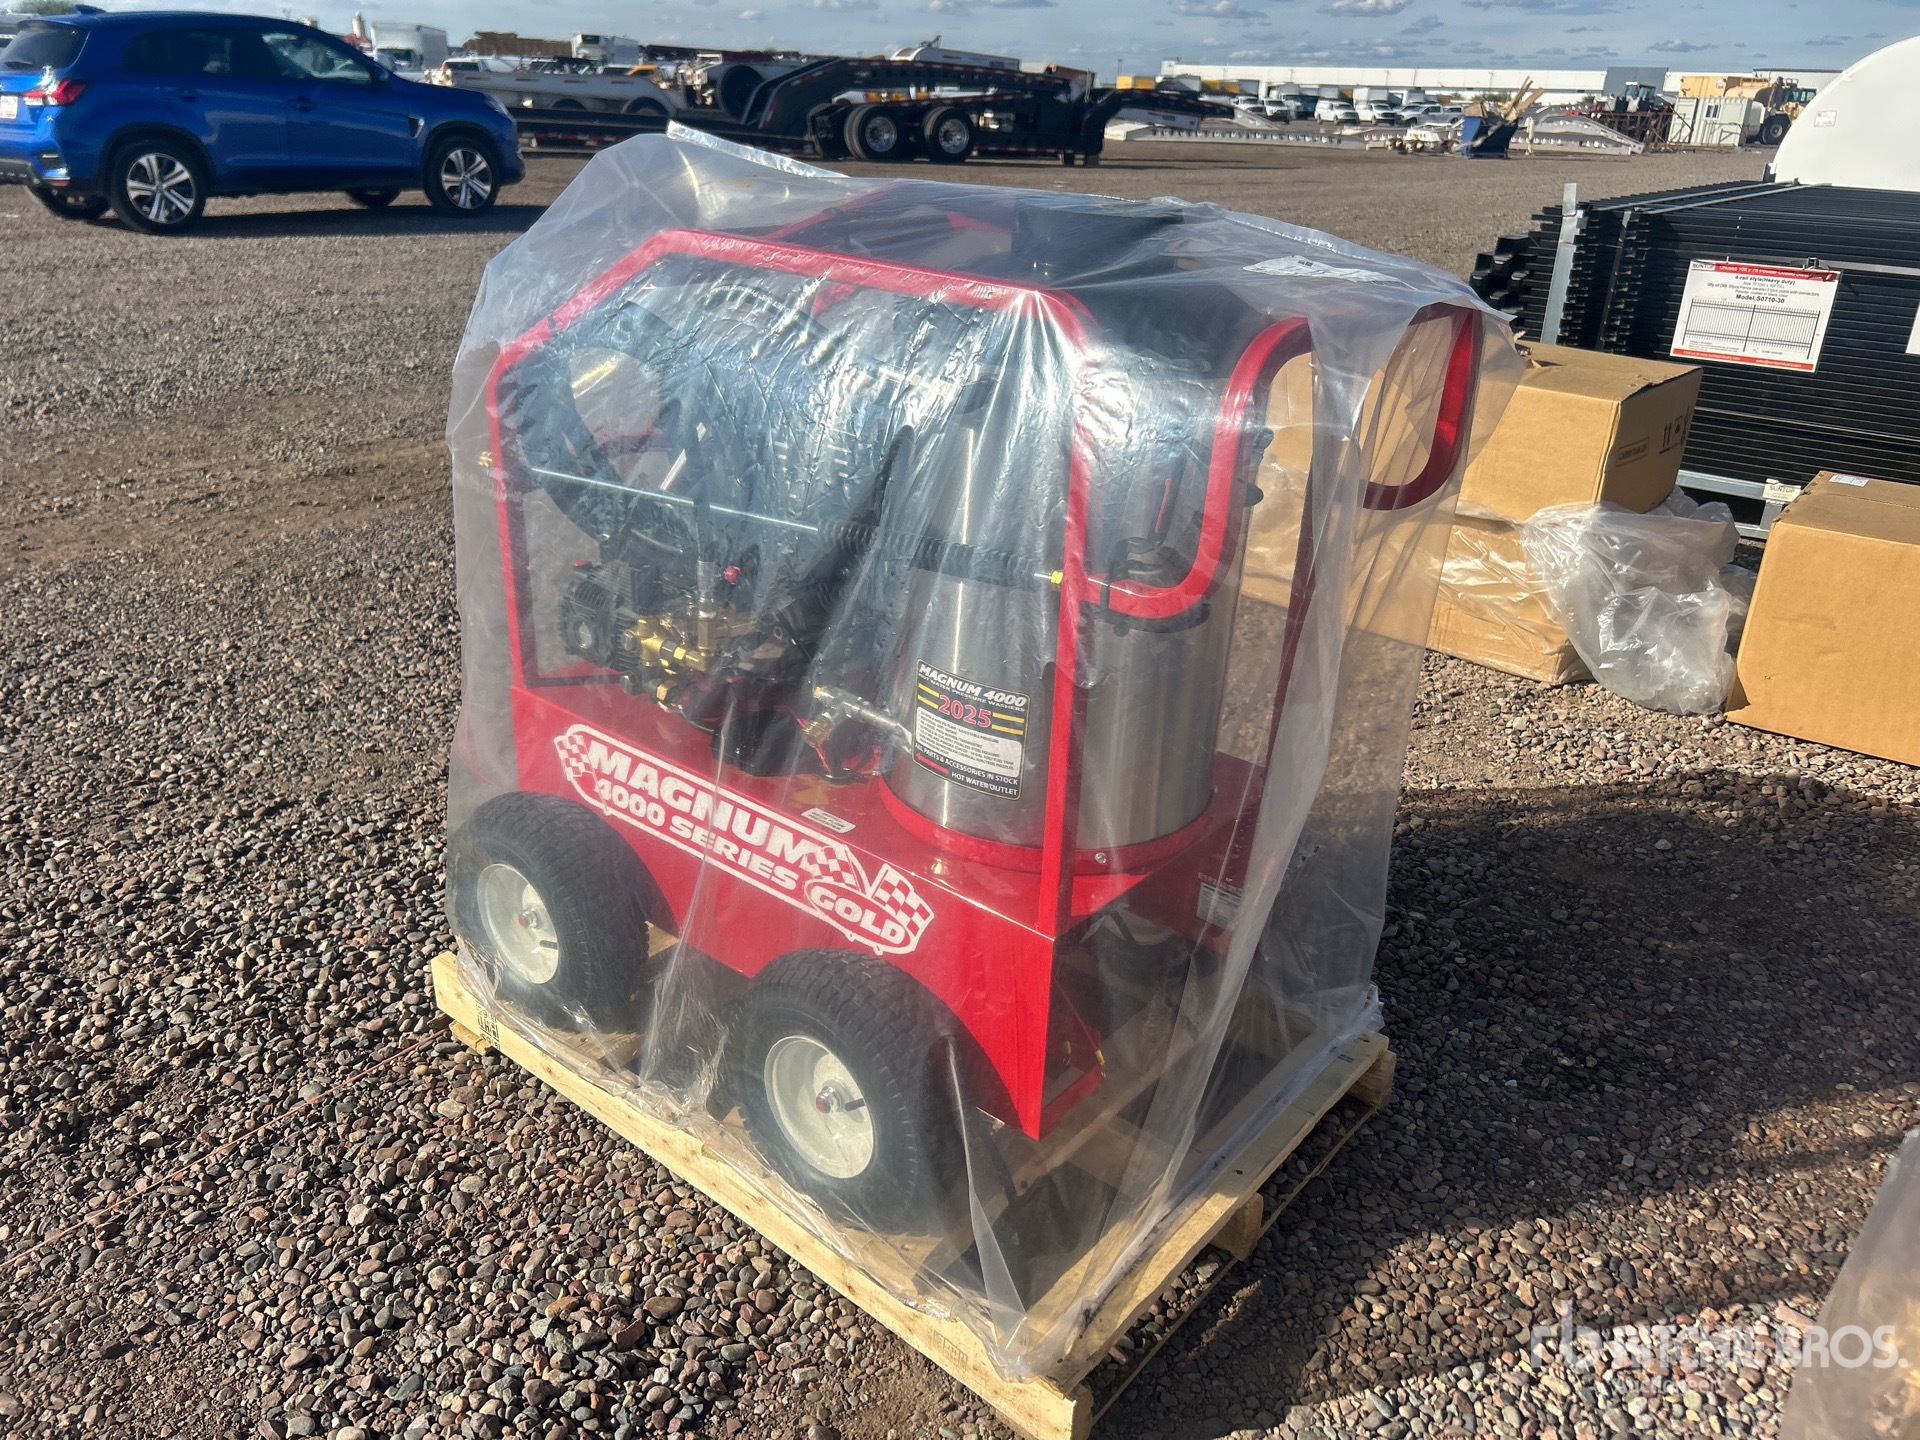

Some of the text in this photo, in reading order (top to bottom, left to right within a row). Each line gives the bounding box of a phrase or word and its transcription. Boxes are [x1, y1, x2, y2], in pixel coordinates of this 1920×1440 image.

[1769, 484, 1795, 493] SUNTOP
[919, 664, 1027, 707] MAGNUM 4000
[930, 679, 952, 693] WATER
[952, 689, 987, 704] PRESSURE
[988, 701, 1026, 713] WASHERS
[938, 694, 992, 728] 2025
[923, 747, 940, 760] PARTS
[945, 757, 986, 779] ACCESSORIES
[987, 772, 994, 780] IN
[995, 773, 1018, 786] STOCK
[951, 772, 1018, 796] HOT WATER OUTLET
[587, 740, 820, 872] MAGNUM
[595, 776, 800, 890] 4000 SERIES
[810, 885, 906, 947] GOLD
